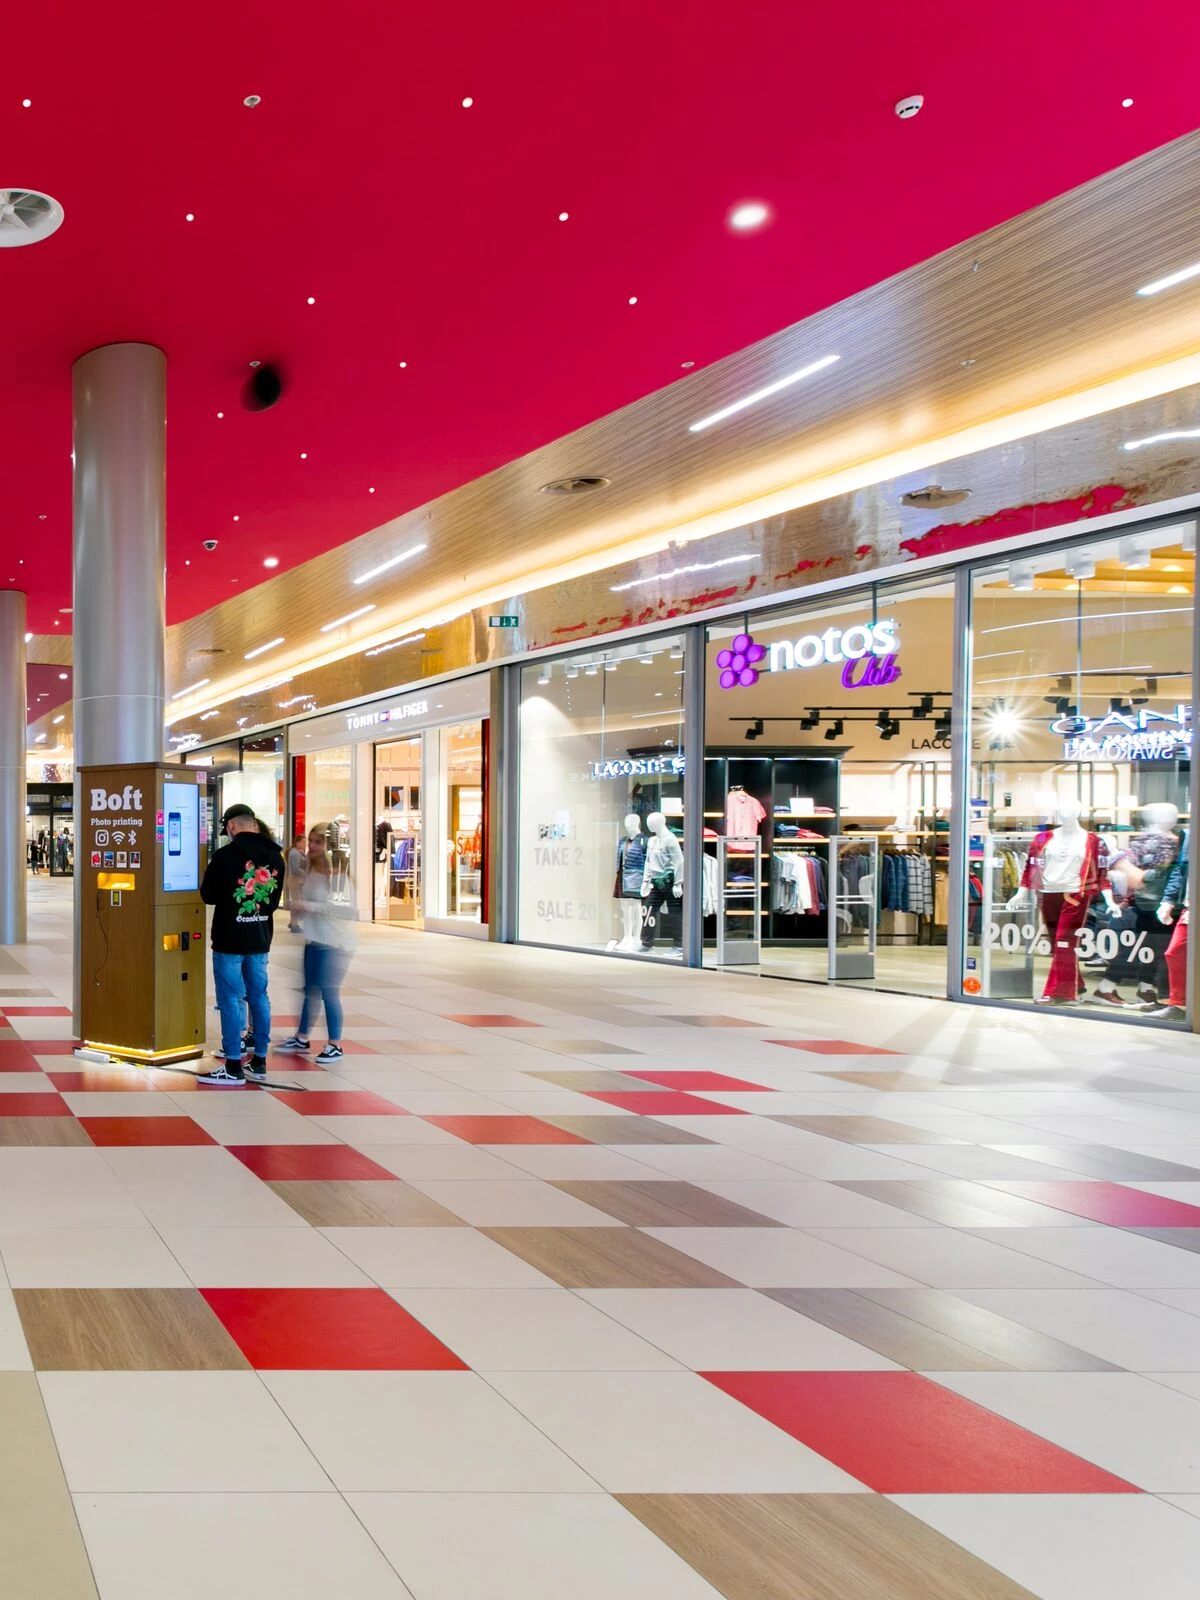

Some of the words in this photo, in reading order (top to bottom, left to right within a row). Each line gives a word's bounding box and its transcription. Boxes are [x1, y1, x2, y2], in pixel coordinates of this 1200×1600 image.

[769, 617, 901, 672] notos
[347, 711, 380, 730] TOMMY
[390, 701, 429, 721] HILFIGER
[1050, 704, 1193, 734] GAN
[912, 739, 981, 749] LACOE
[90, 785, 143, 811] Boft
[90, 818, 111, 826] Photo
[112, 817, 142, 827] printing
[533, 848, 569, 866] TAKE
[573, 847, 584, 866] 2
[537, 900, 573, 919] SALE
[983, 922, 1051, 956] 20%
[1074, 927, 1155, 964] 30%
